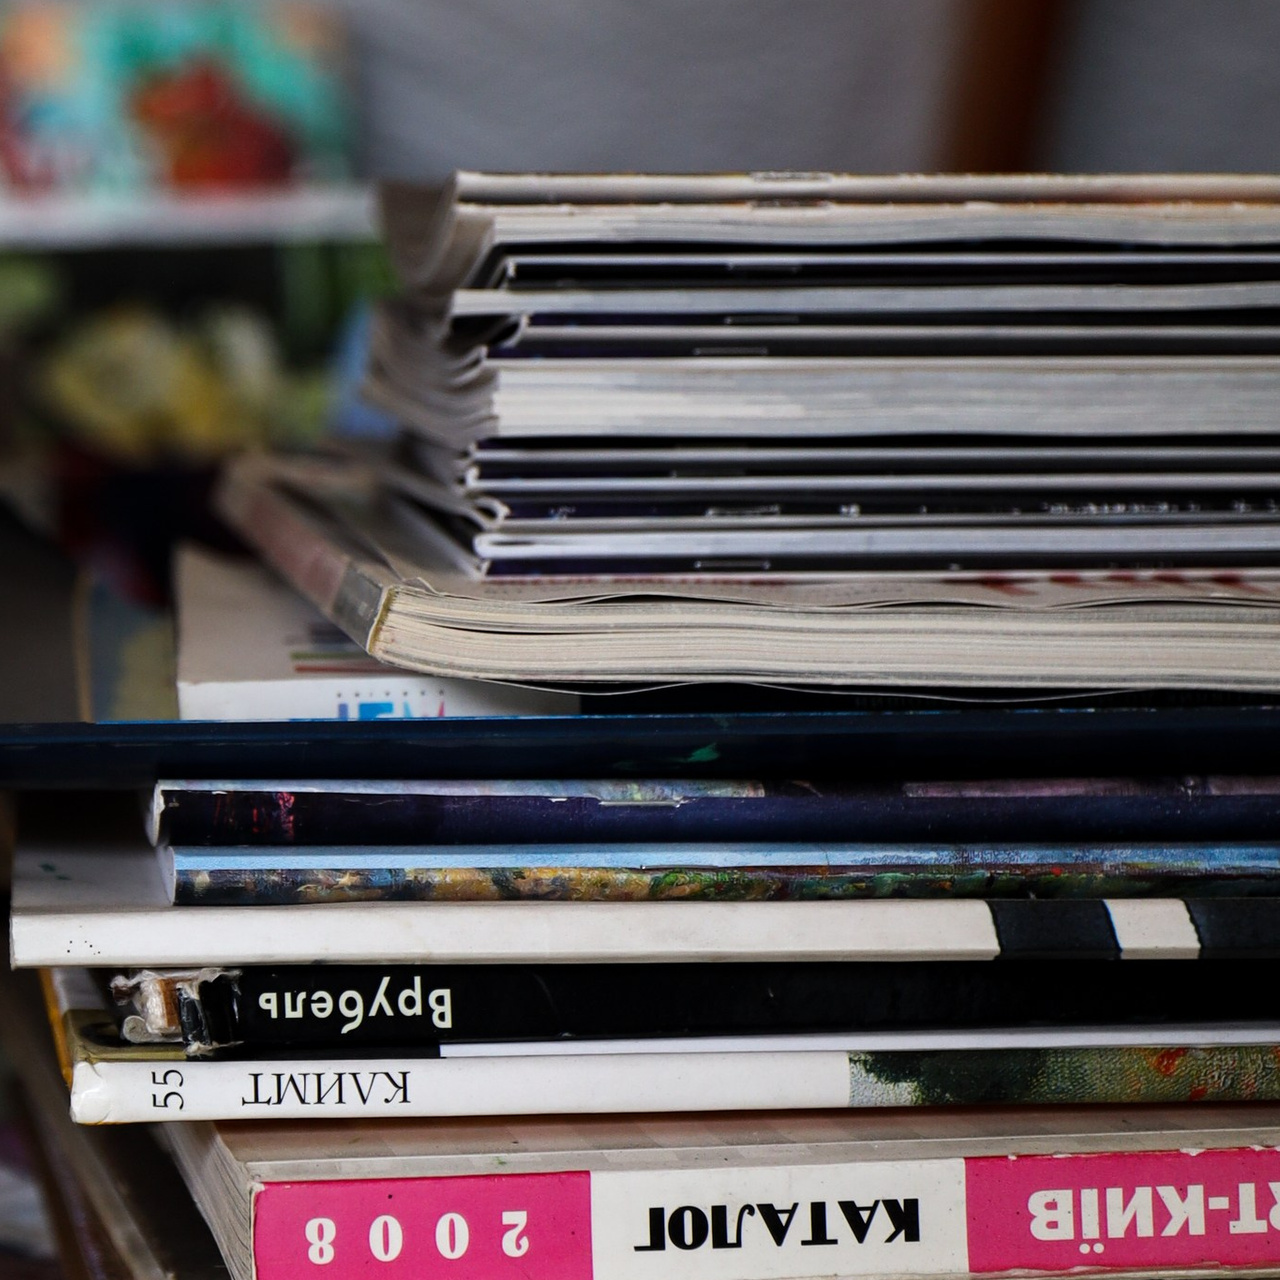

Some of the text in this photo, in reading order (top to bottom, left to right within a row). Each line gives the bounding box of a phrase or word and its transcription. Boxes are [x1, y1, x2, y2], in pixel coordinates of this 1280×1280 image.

[258, 976, 453, 1034] Врубель
[151, 1067, 185, 1110] 55
[241, 1070, 412, 1106] КЛИМТ
[634, 1197, 921, 1252] КАТАЛОГ
